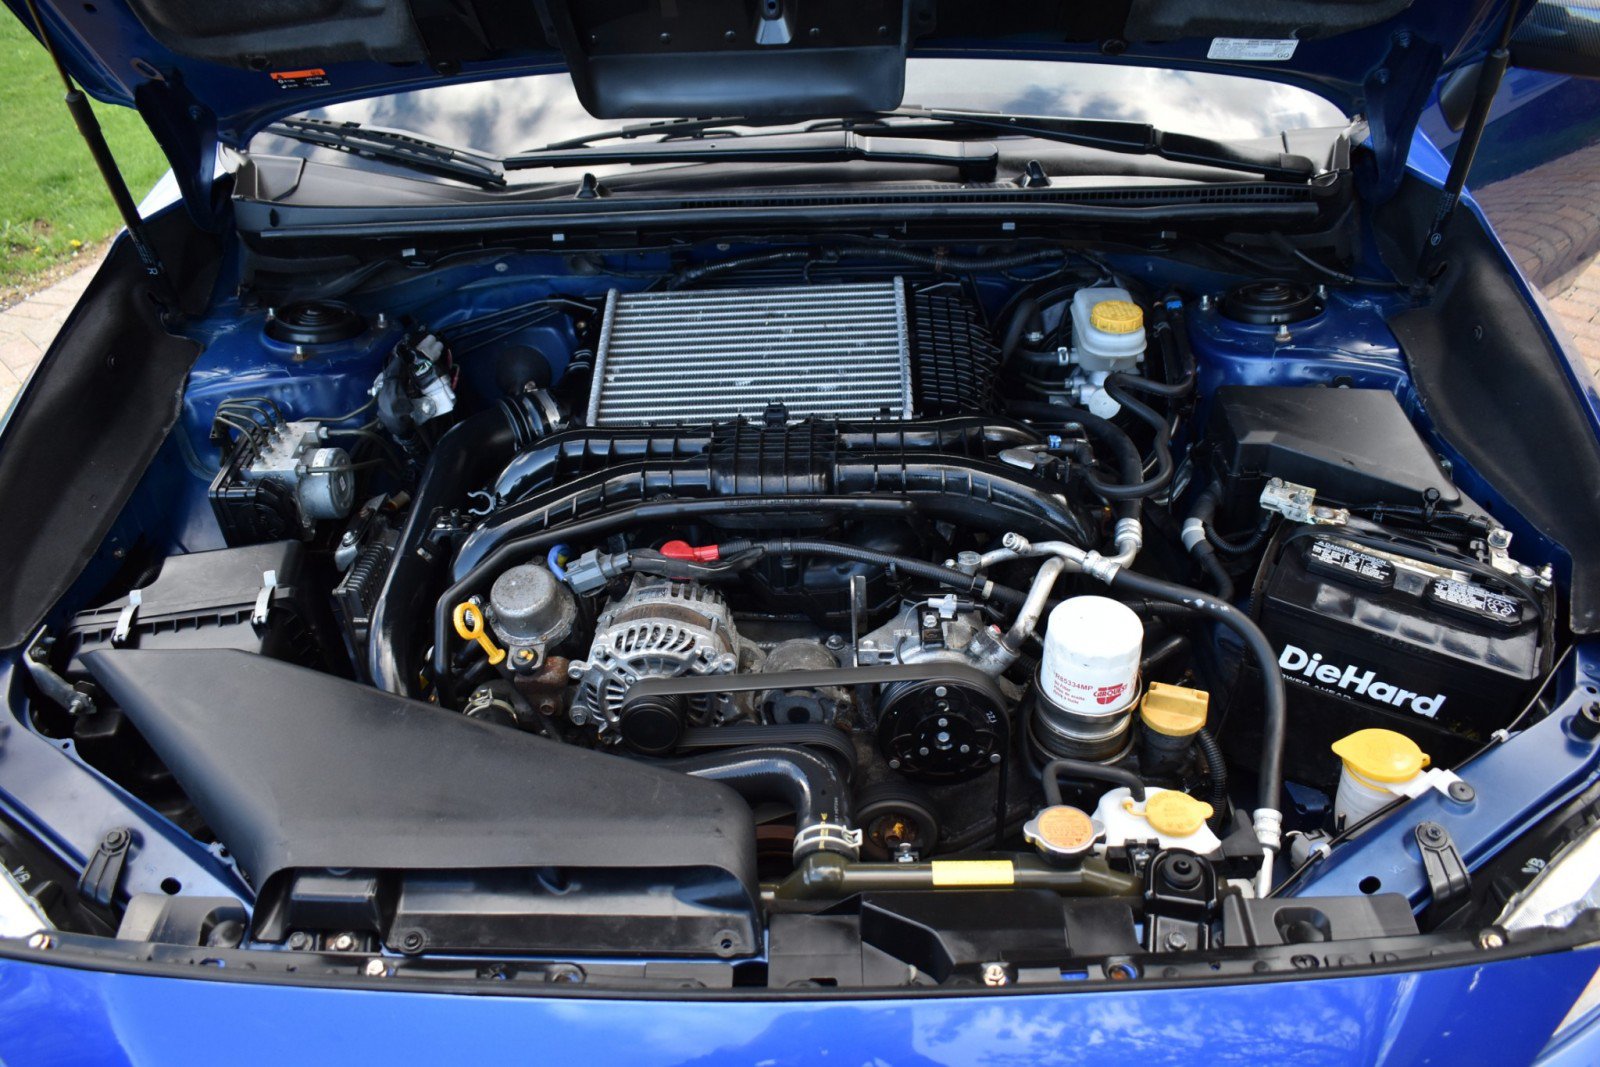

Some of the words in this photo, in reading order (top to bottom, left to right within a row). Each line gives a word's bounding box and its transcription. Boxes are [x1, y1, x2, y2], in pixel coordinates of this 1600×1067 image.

[1324, 541, 1354, 556] DANGER
[1360, 552, 1388, 566] POISON
[1278, 644, 1447, 719] DieHard
